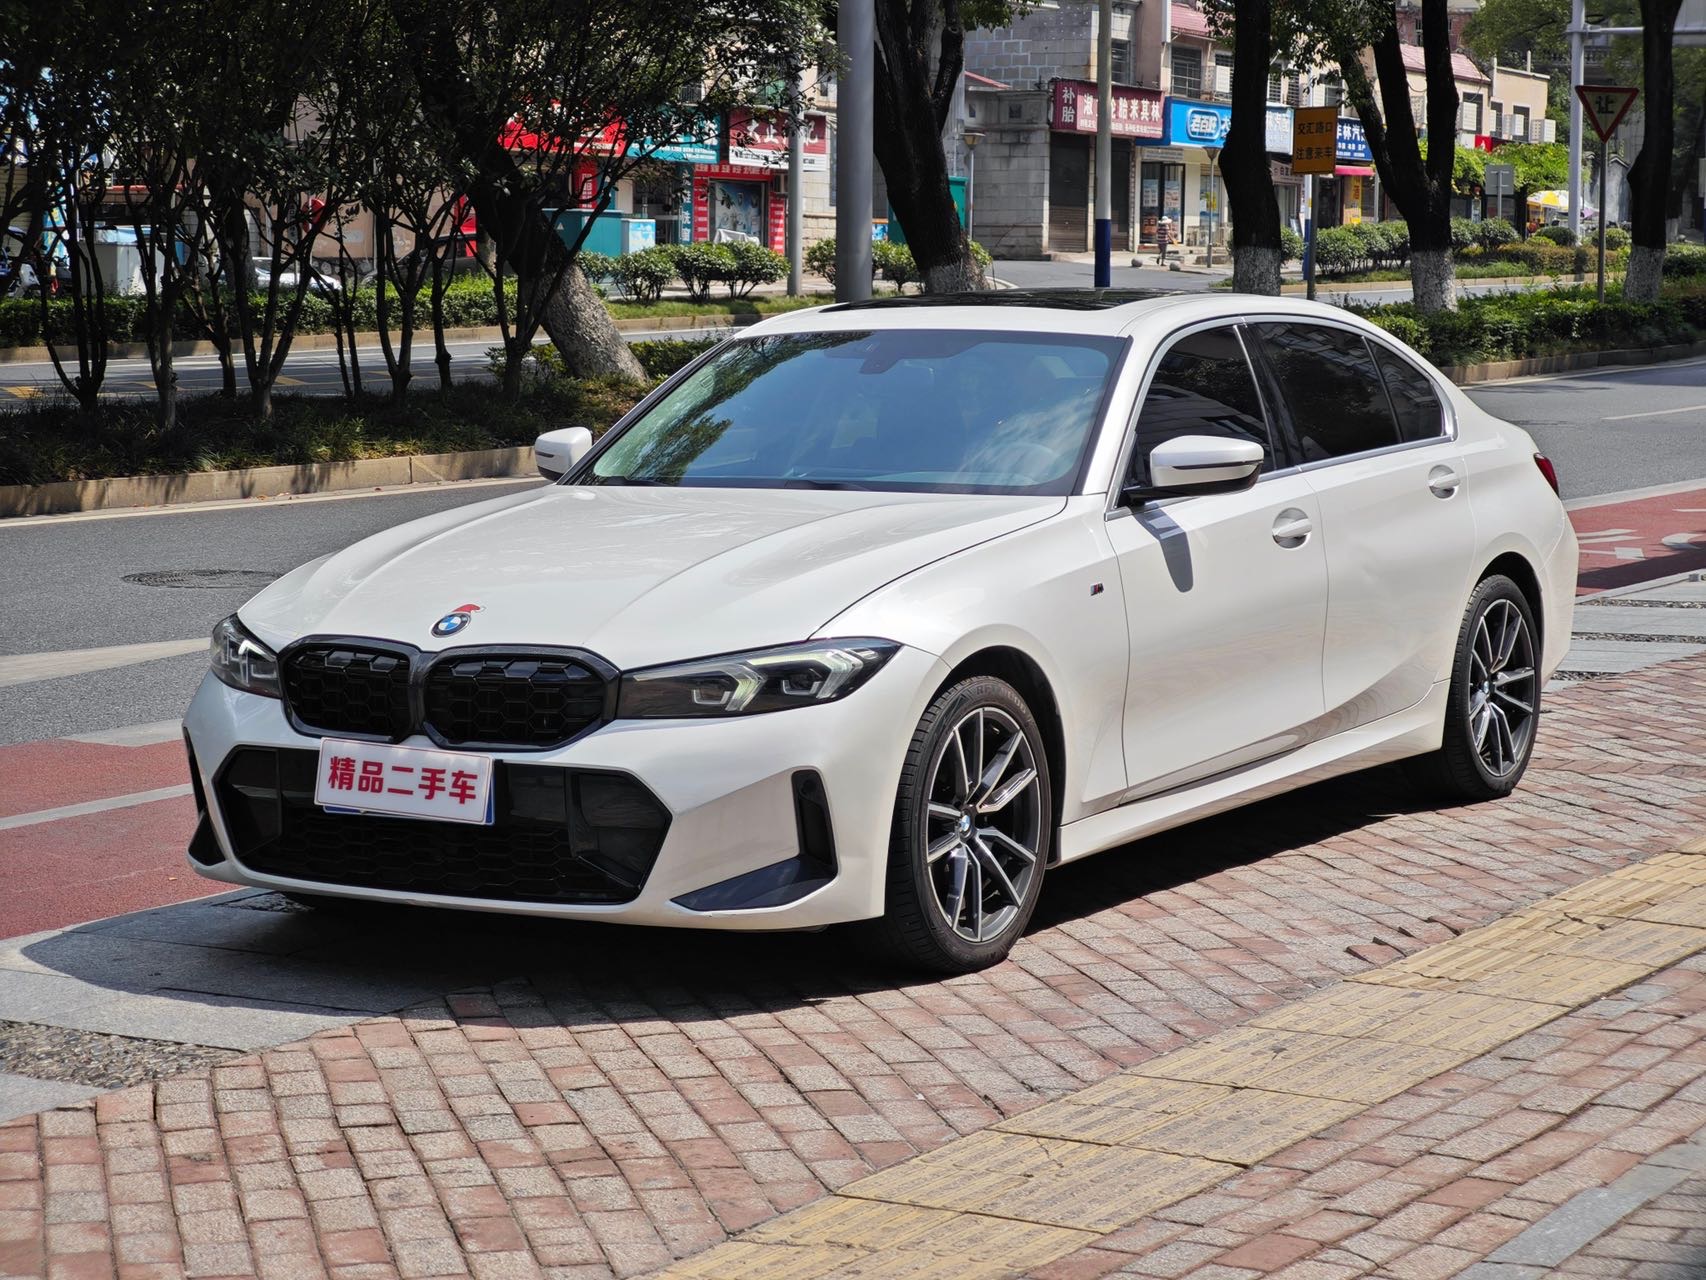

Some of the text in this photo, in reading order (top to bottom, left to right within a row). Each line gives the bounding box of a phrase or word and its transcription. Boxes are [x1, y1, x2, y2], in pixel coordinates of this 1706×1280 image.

[1061, 86, 1076, 123] 补胎
[1596, 96, 1616, 114] 让
[1298, 122, 1332, 135] 交汇路口
[328, 756, 478, 804] 精品二手车
